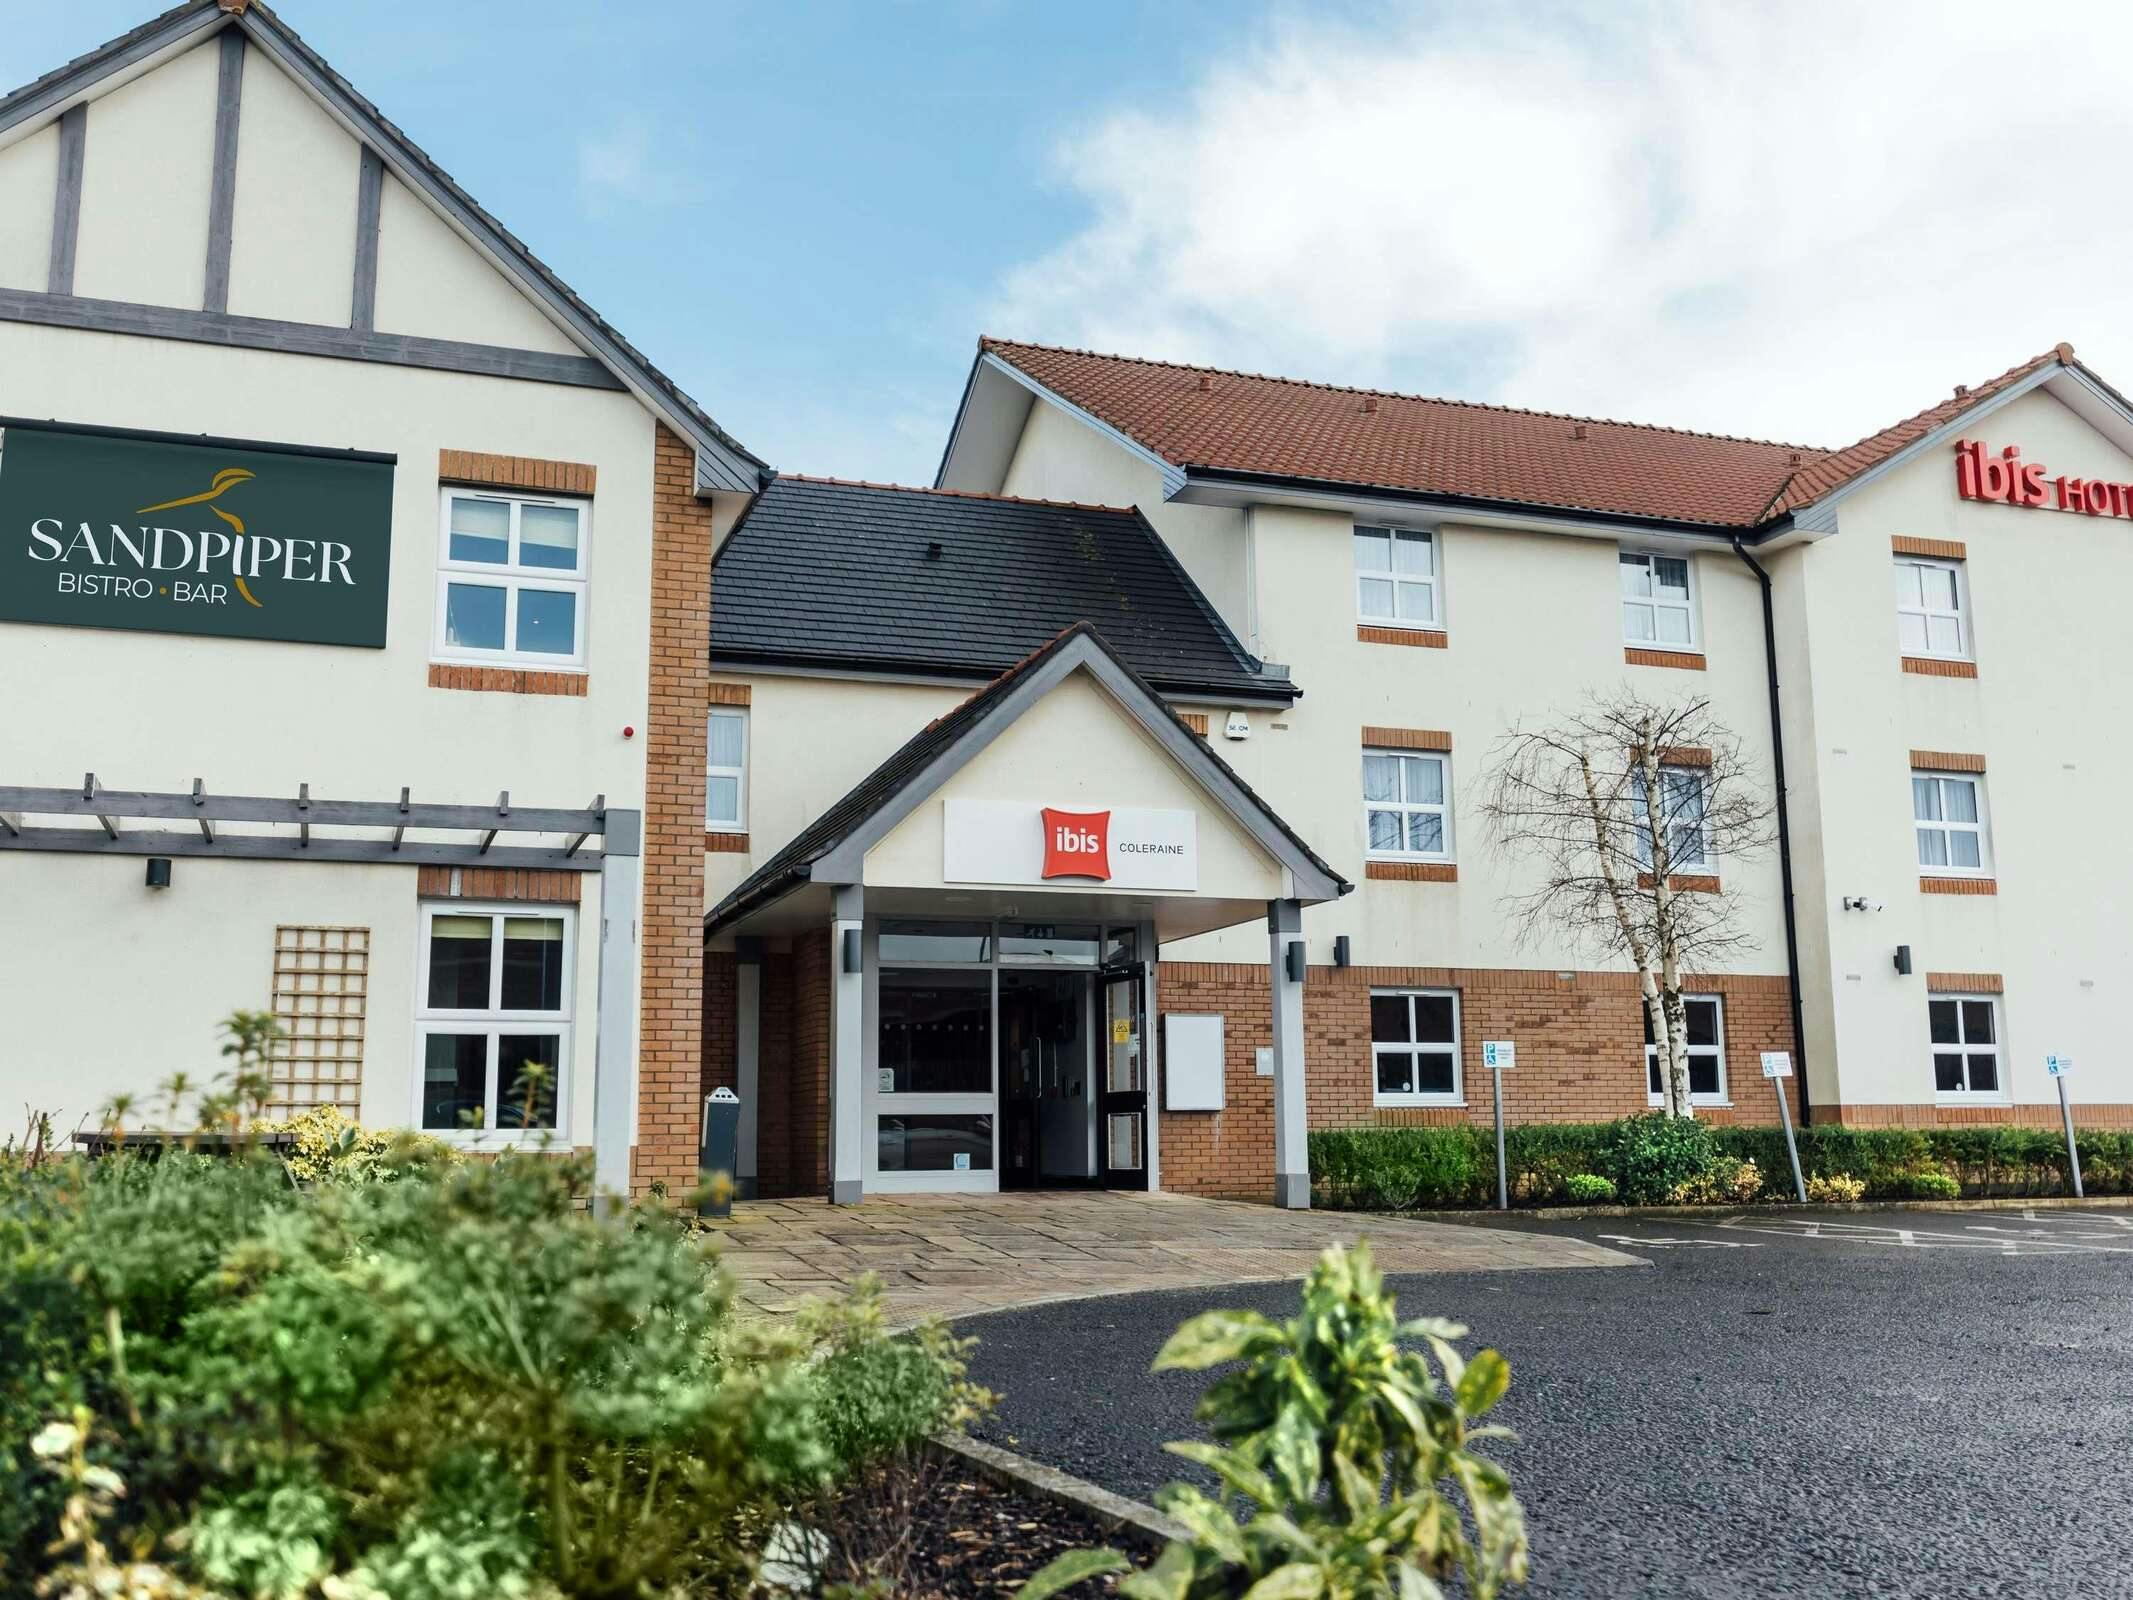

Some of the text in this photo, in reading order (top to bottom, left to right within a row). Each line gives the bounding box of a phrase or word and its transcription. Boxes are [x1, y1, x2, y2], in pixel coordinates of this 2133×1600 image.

[1953, 439, 2133, 517] ibis HOT
[28, 518, 356, 585] SANDPIPER
[58, 572, 228, 605] BISTRO BAR
[1056, 826, 1100, 854] ibis
[1119, 842, 1184, 855] COLERAINE
